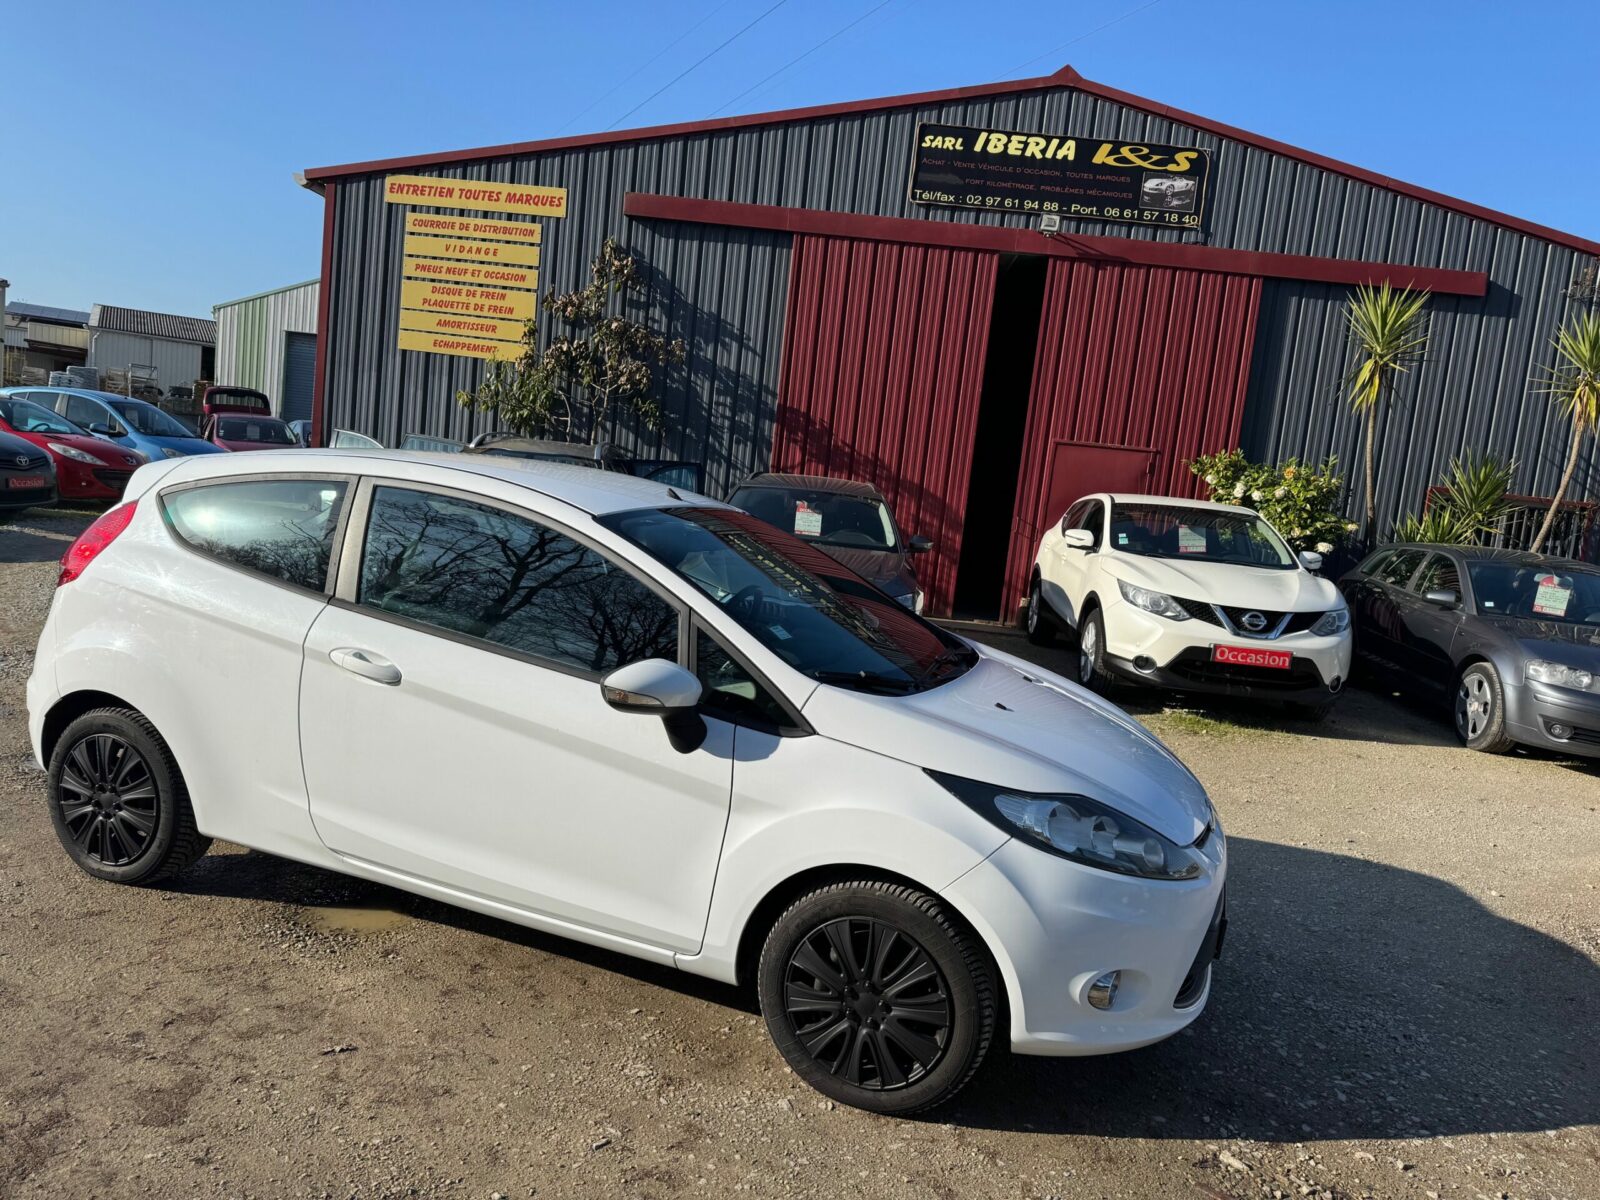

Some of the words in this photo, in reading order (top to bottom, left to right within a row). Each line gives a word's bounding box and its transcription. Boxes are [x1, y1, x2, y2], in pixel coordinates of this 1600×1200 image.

[921, 135, 964, 150] SARL
[973, 131, 1076, 161] IBERIA
[921, 158, 946, 166] ACHAT
[953, 160, 976, 168] VENTE
[1066, 171, 1093, 180] TOUTES
[1096, 175, 1131, 183] MARQUES
[965, 178, 985, 186] FORT
[389, 182, 454, 199] ENTRETIEN
[458, 188, 502, 203] TOUTES
[505, 192, 563, 208] MARQUES
[914, 189, 955, 203] Tél/fax
[966, 194, 982, 205] 02
[985, 197, 1002, 207] 97
[1004, 199, 1019, 208] 61
[1024, 200, 1039, 210] 94
[1043, 201, 1058, 211] 88
[1071, 204, 1100, 216] Port.
[1104, 207, 1120, 217] 06
[1123, 209, 1138, 219] 61
[1143, 211, 1159, 220] 57
[1164, 214, 1179, 223] 18
[1182, 215, 1199, 224] 40
[412, 218, 456, 231] COURROIE
[458, 222, 470, 231] DE
[473, 223, 535, 237] DISTRIBUTION
[445, 243, 499, 256] VIDANGE
[415, 263, 443, 274] PNEUS
[445, 266, 469, 276] NEUF
[471, 269, 481, 277] ET
[484, 270, 526, 283] OCCASION
[431, 286, 462, 297] DISQUE
[465, 289, 477, 298] DE
[480, 291, 506, 301] FREIN
[422, 298, 470, 310] PLAQUETTE
[473, 303, 484, 312] DE
[487, 305, 514, 315] FREIN
[436, 319, 497, 333] AMORTISSEUR
[432, 339, 498, 353] ECHAPPEMENT
[1216, 647, 1289, 666] Occasion
